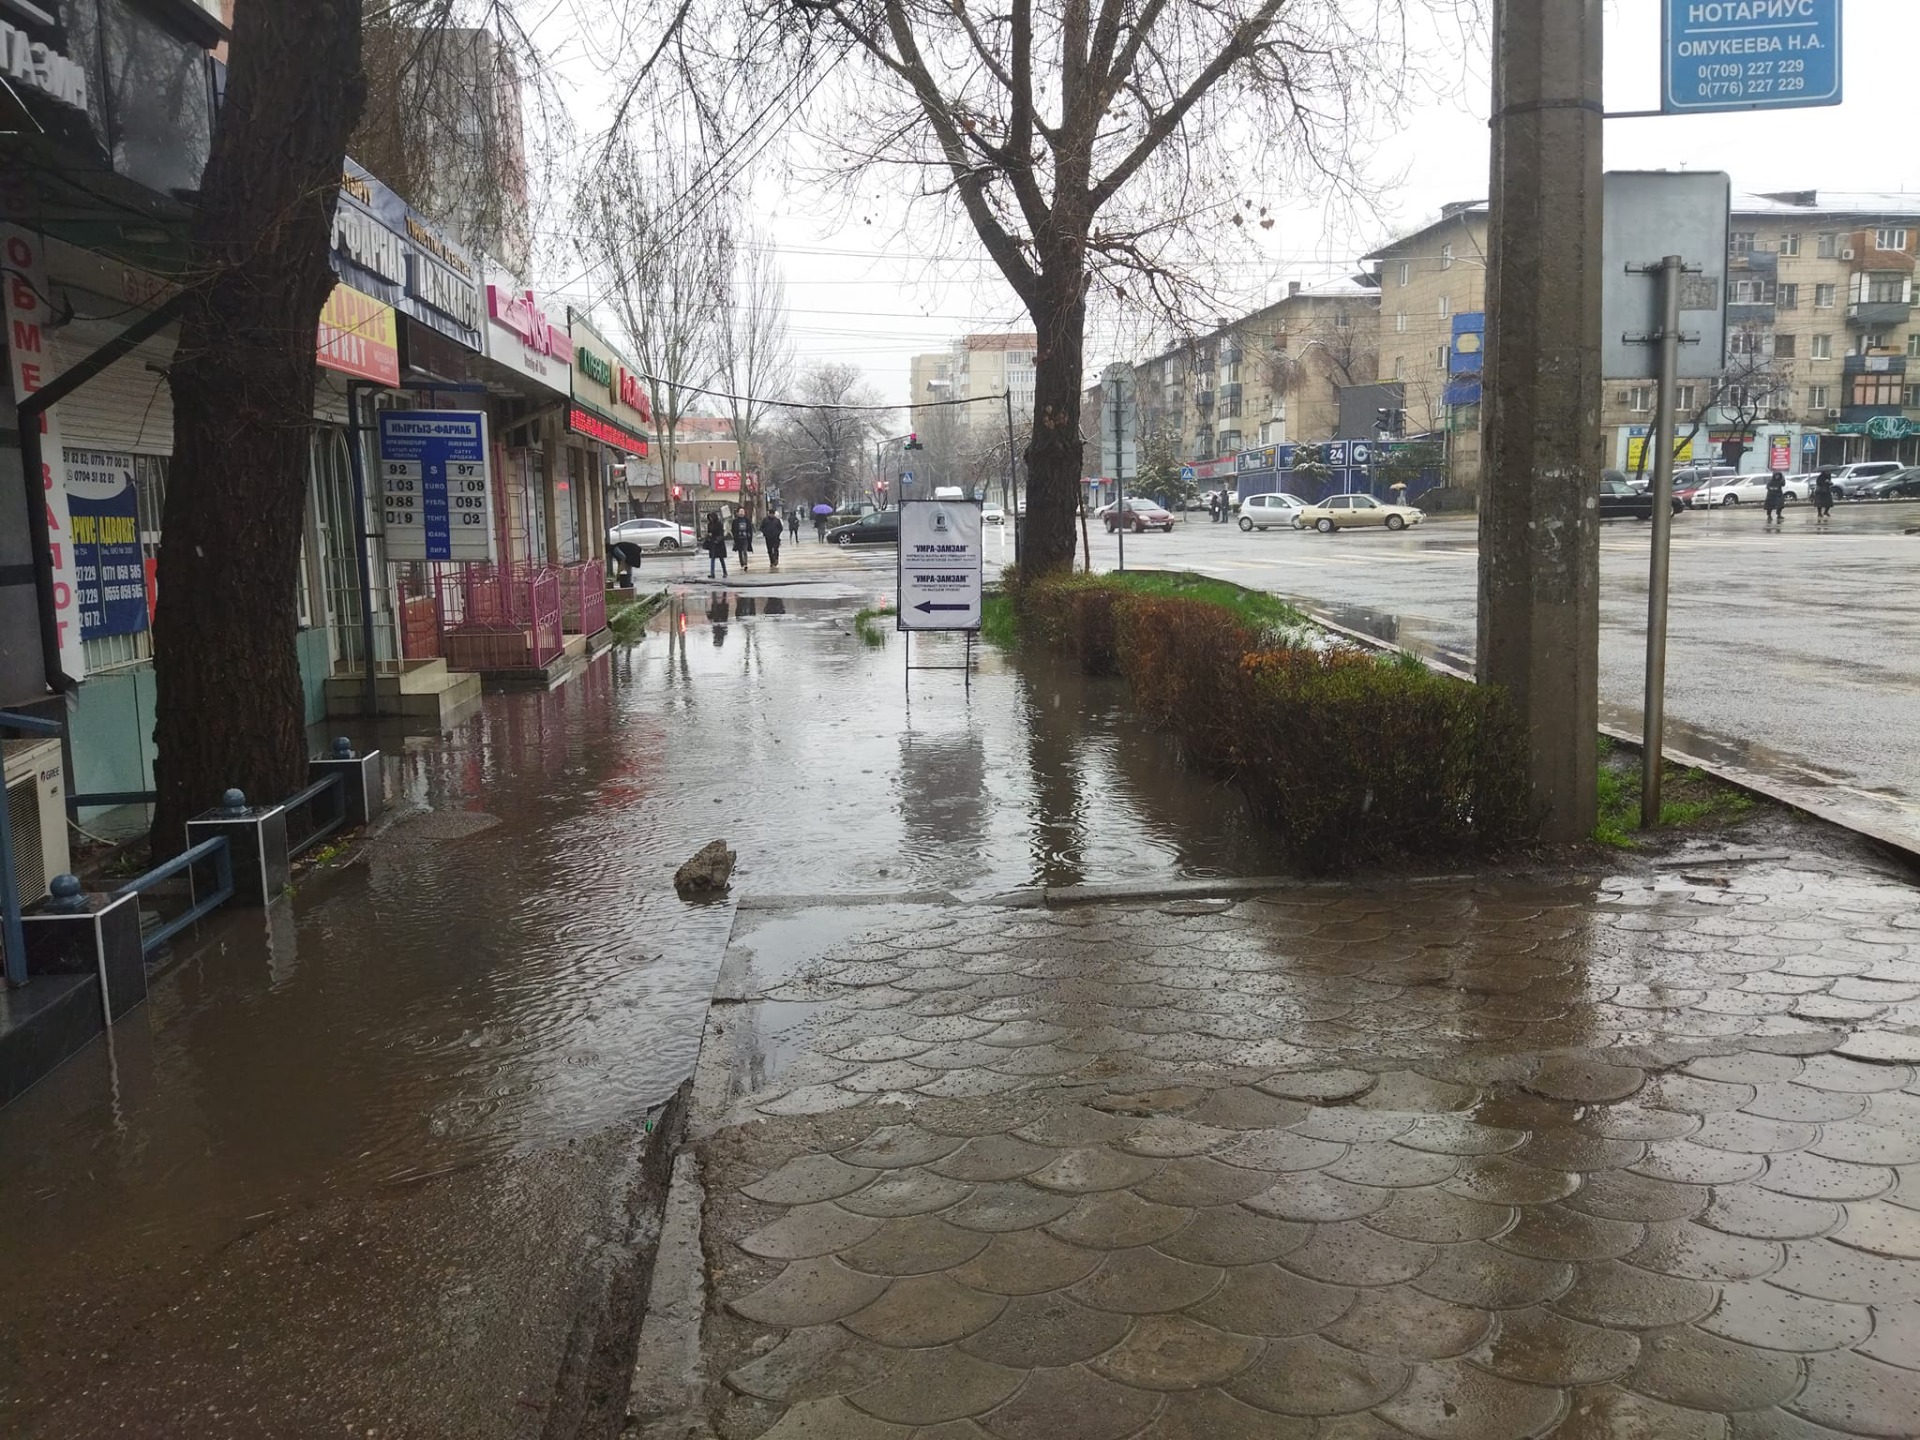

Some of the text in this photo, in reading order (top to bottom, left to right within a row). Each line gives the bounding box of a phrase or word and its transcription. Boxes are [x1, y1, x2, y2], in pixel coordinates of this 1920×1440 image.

[1689, 0, 1813, 23] НОТАРИУС
[1678, 34, 1825, 57] ОМУКЕЕВА Н.А.
[1698, 59, 1804, 80] 0(709) 227 229
[1698, 77, 1804, 97] 0(776) 227 229
[1330, 449, 1343, 460] 24
[390, 464, 407, 475] 92
[458, 464, 474, 475] 97
[387, 480, 414, 492] 103
[459, 481, 485, 493] 109
[385, 496, 414, 507] 088
[456, 496, 482, 508] 095
[386, 511, 413, 525] 019
[463, 513, 481, 525] 02
[99, 516, 136, 546] АДВОКАТ
[84, 565, 96, 580] 229
[86, 588, 98, 603] 229
[46, 766, 60, 780] GREE
